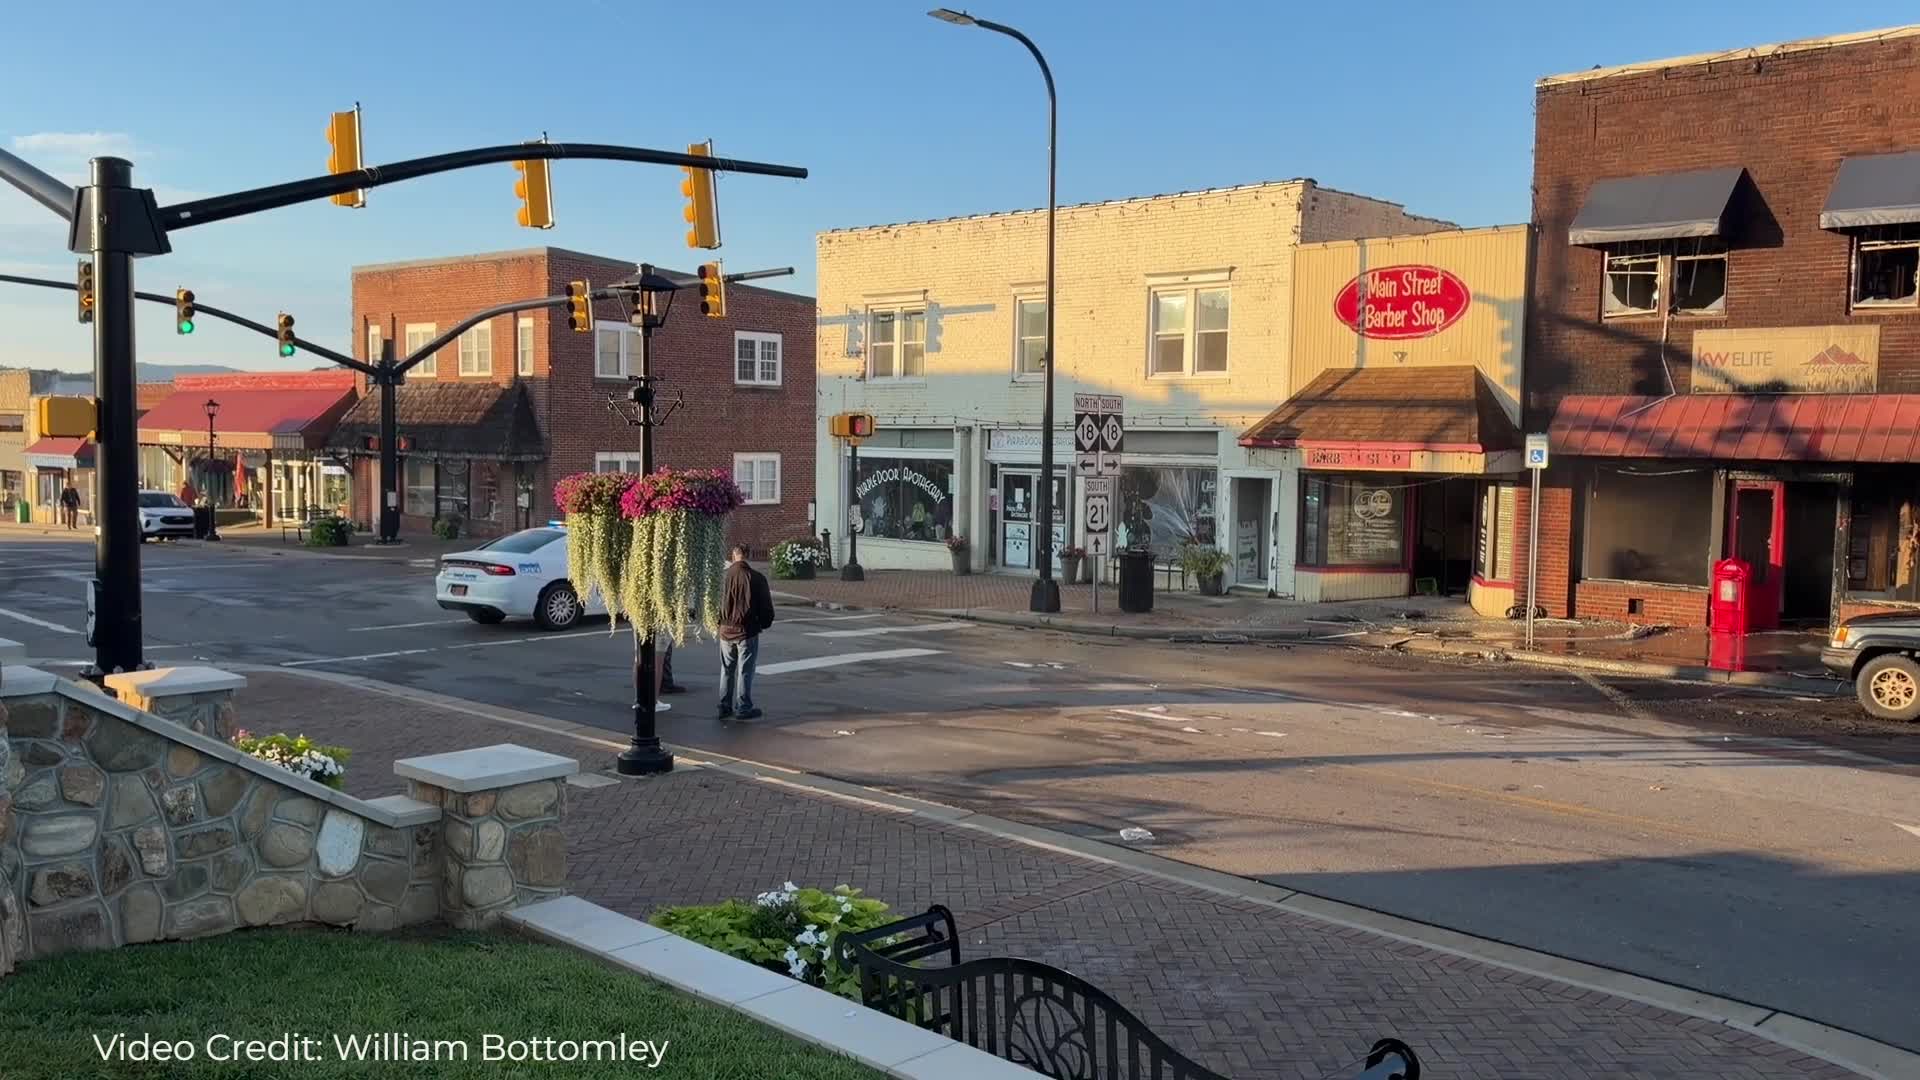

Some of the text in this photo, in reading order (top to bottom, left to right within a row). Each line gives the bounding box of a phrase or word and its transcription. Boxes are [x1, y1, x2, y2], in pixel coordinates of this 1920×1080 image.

[1367, 271, 1443, 299] Main Street
[1365, 301, 1445, 332] Barber Shop
[1732, 351, 1773, 367] ELITE
[1075, 397, 1098, 409] NORTH
[1101, 398, 1122, 409] SOUTH
[1081, 424, 1094, 441] 18
[1106, 424, 1118, 441] 18
[903, 466, 946, 504] APOTHECARY
[1087, 480, 1108, 492] SOUTH
[1090, 504, 1105, 525] 21
